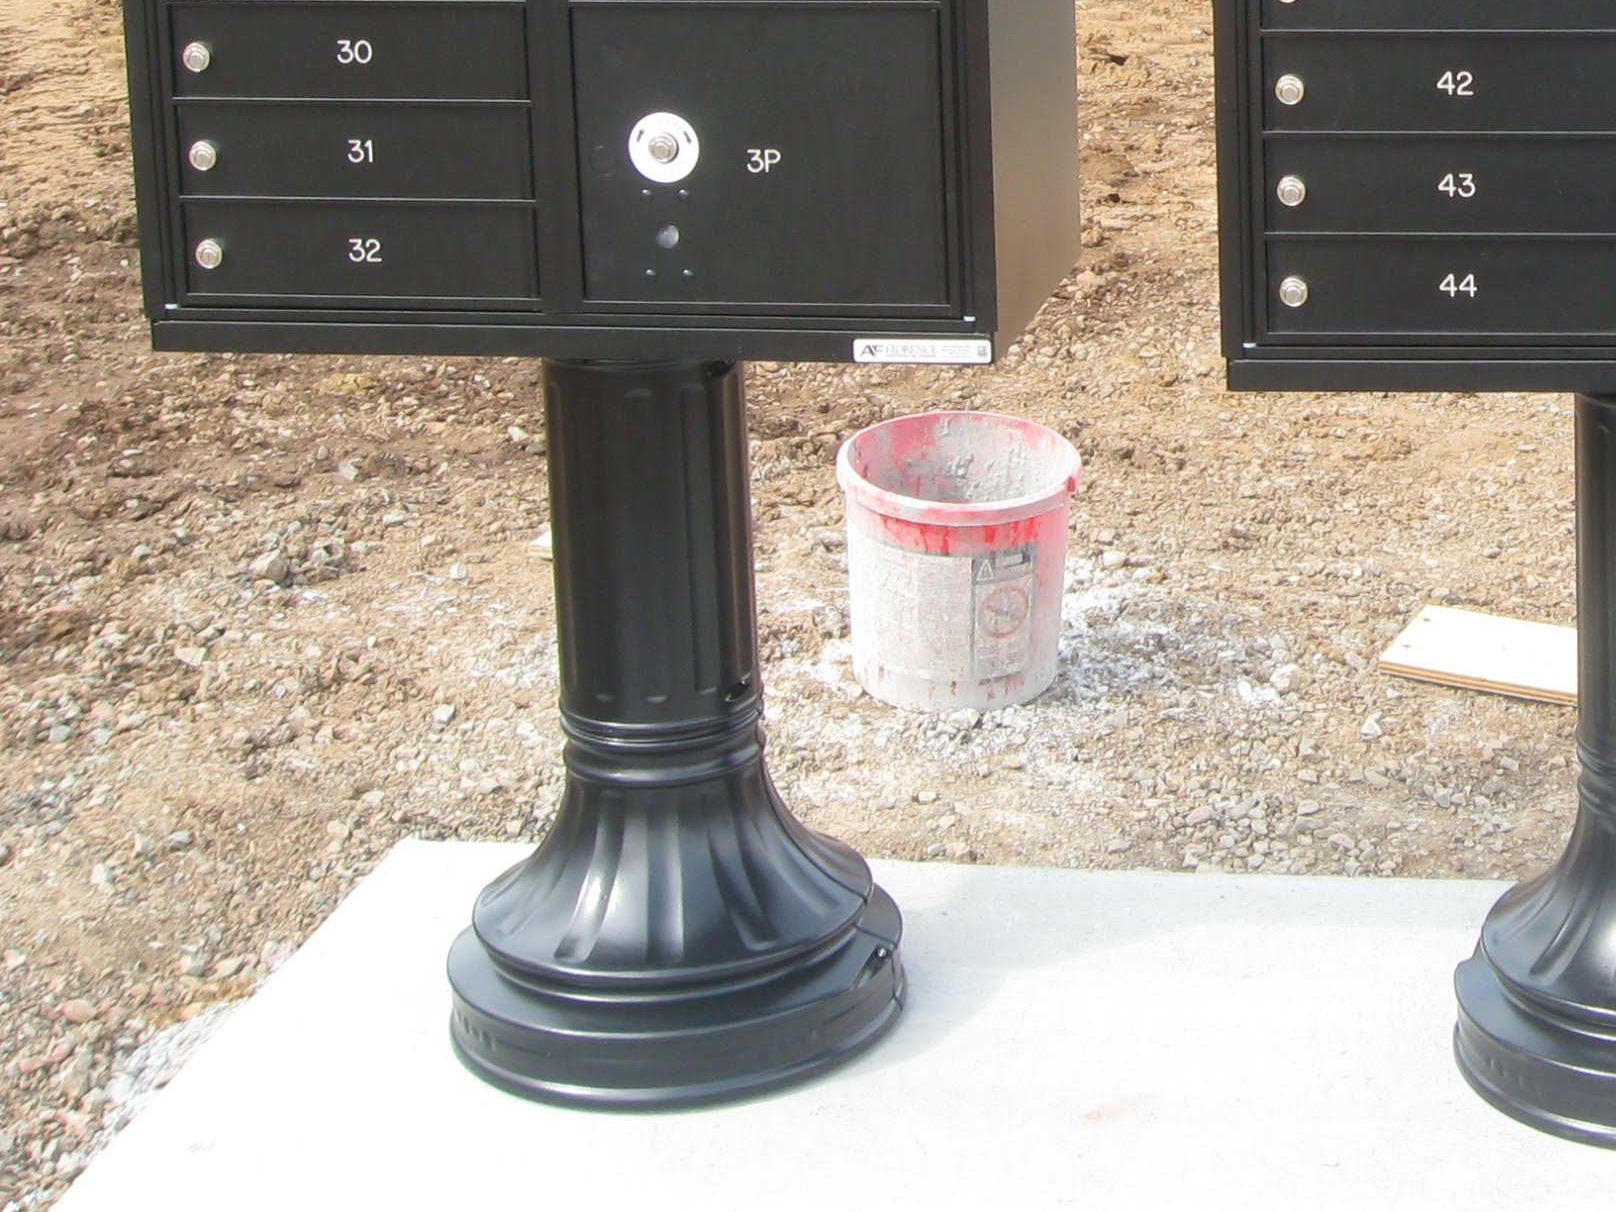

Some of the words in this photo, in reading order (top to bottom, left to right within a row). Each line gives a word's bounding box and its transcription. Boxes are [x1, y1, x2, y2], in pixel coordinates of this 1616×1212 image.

[336, 39, 373, 64] 30
[1436, 70, 1474, 96] 42
[347, 139, 374, 164] 31
[746, 148, 782, 174] 3P
[1437, 173, 1476, 198] 43
[348, 238, 383, 263] 32
[1438, 273, 1478, 298] 44
[885, 344, 938, 355] FLORENCE
